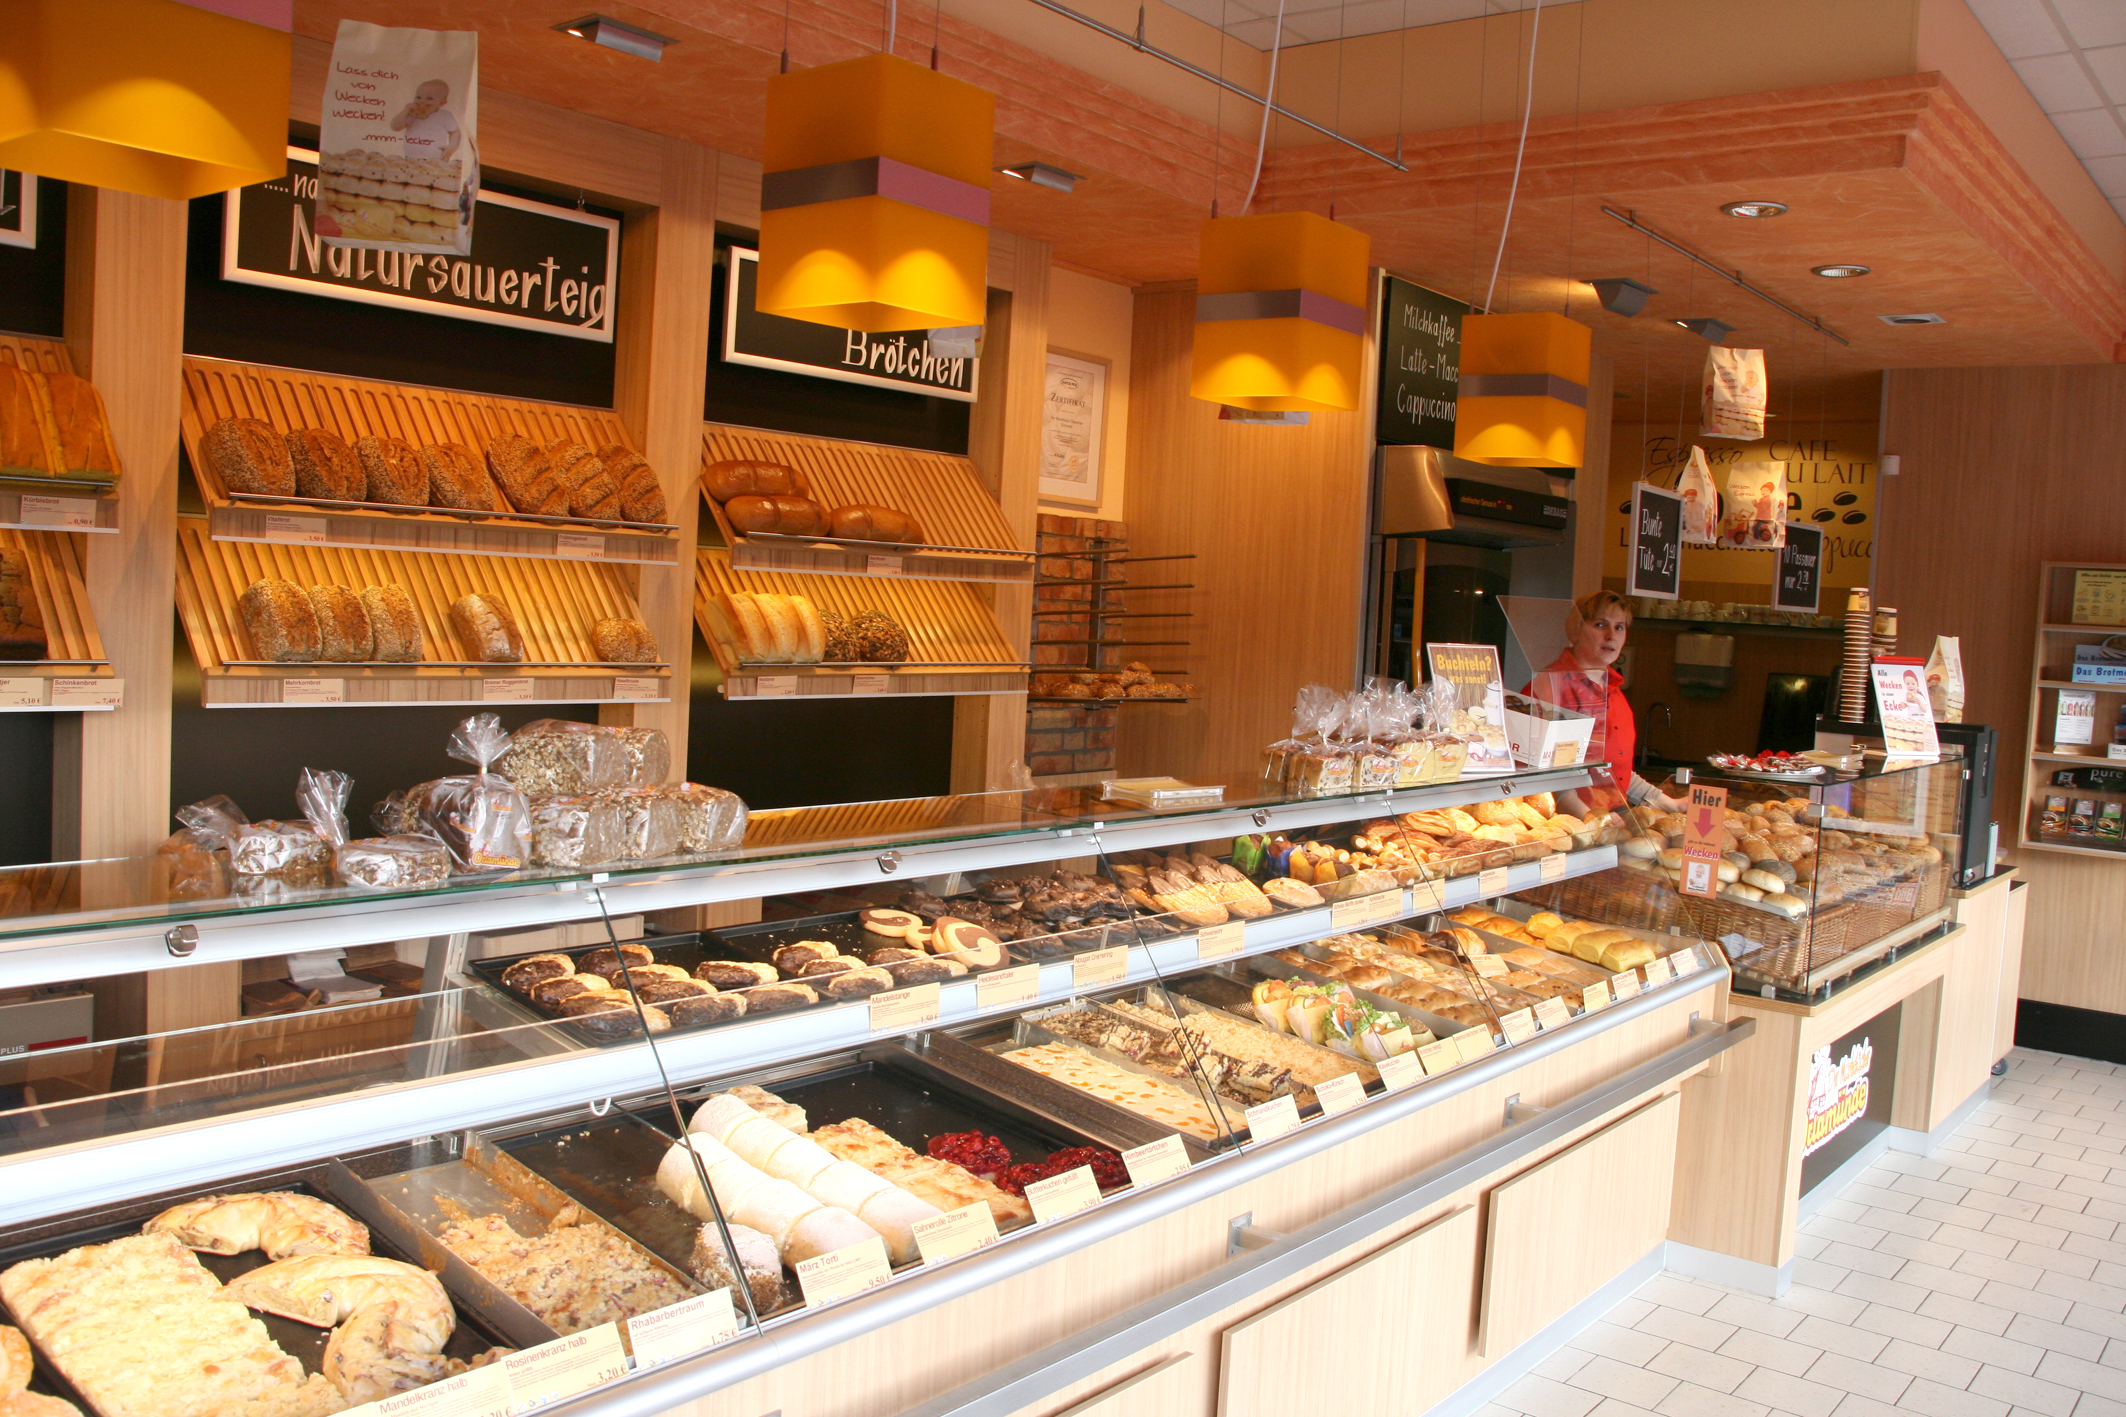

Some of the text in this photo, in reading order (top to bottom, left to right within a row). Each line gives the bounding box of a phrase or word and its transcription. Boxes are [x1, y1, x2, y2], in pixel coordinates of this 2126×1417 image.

[336, 61, 399, 80] Lass dich
[350, 81, 376, 91] von
[335, 90, 386, 107] Wecken
[332, 110, 386, 122] wecken!
[405, 135, 435, 146] lecker
[1403, 303, 1455, 348] Milchkaffee
[841, 328, 964, 388] Brötchen
[1396, 383, 1456, 425] Cappuccino
[1813, 463, 1873, 484] LAIT
[23, 496, 59, 504] Kürbisbrot
[1640, 508, 1663, 538] Bunte
[1435, 653, 1493, 672] Buchteln?
[2076, 666, 2092, 676] Das
[1465, 674, 1486, 684] sonst!
[1879, 680, 1903, 690] Wecken
[1883, 699, 1903, 712] Ecke
[2090, 768, 2124, 781] pure
[1692, 788, 1722, 807] Hier
[1684, 845, 1719, 861] Wecken
[872, 990, 911, 1004] Mandelstange
[0, 1044, 25, 1055] PLUS
[1247, 1101, 1283, 1118] Schmandkuchen
[1124, 1141, 1169, 1161] Himbeertörtchen
[1026, 1180, 1063, 1196] Butterkuchen
[913, 1210, 968, 1234] Sahnerolle Zitrone
[978, 1236, 993, 1249] 2,40
[799, 1260, 820, 1274] März
[868, 1273, 892, 1288] 9,50 €
[631, 1300, 705, 1331] Rhabarbertraum
[712, 1327, 738, 1346] 1,75 €
[505, 1335, 588, 1371] Rosinenkranz halb
[598, 1363, 626, 1384] 3,20 €
[378, 1376, 468, 1415] Mandelkranz halb
